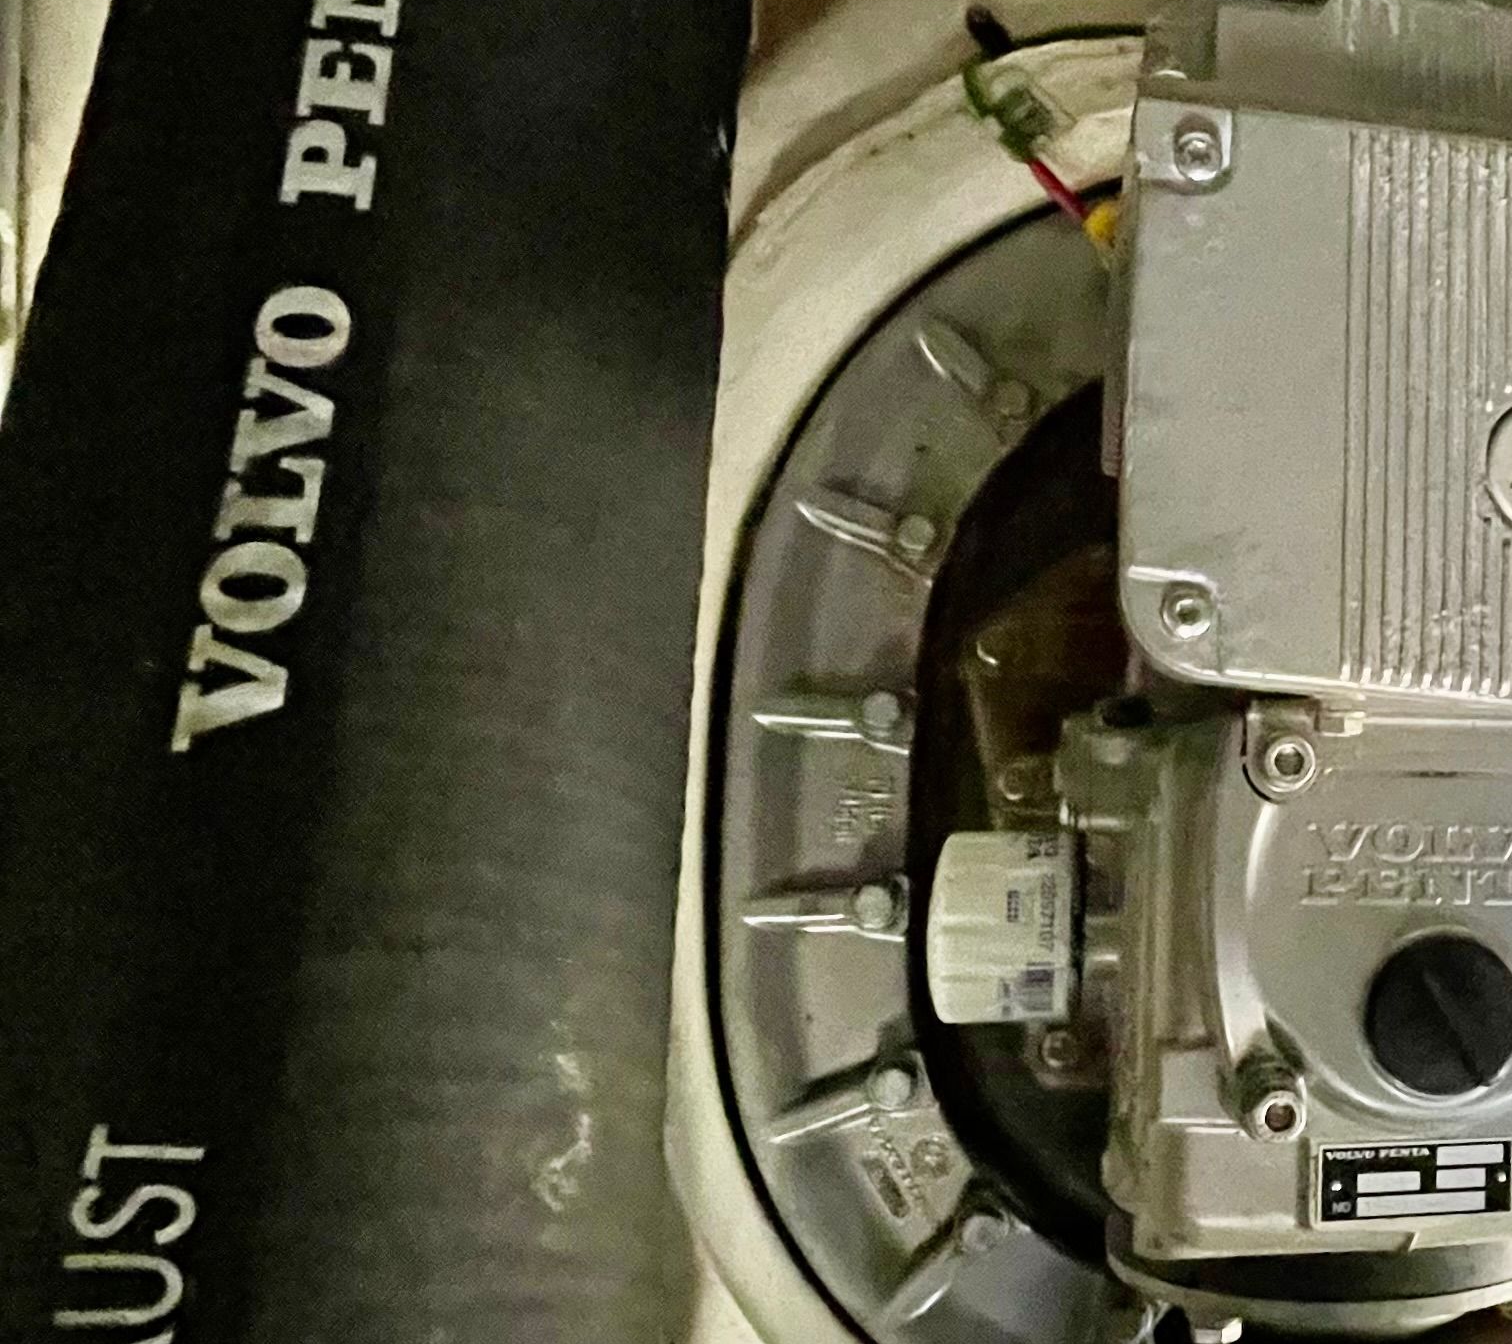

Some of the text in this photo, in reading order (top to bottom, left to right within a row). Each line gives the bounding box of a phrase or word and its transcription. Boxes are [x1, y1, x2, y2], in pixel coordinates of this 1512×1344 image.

[170, 285, 351, 752] VOLVO
[1325, 1147, 1431, 1161] VOLVO PENTA
